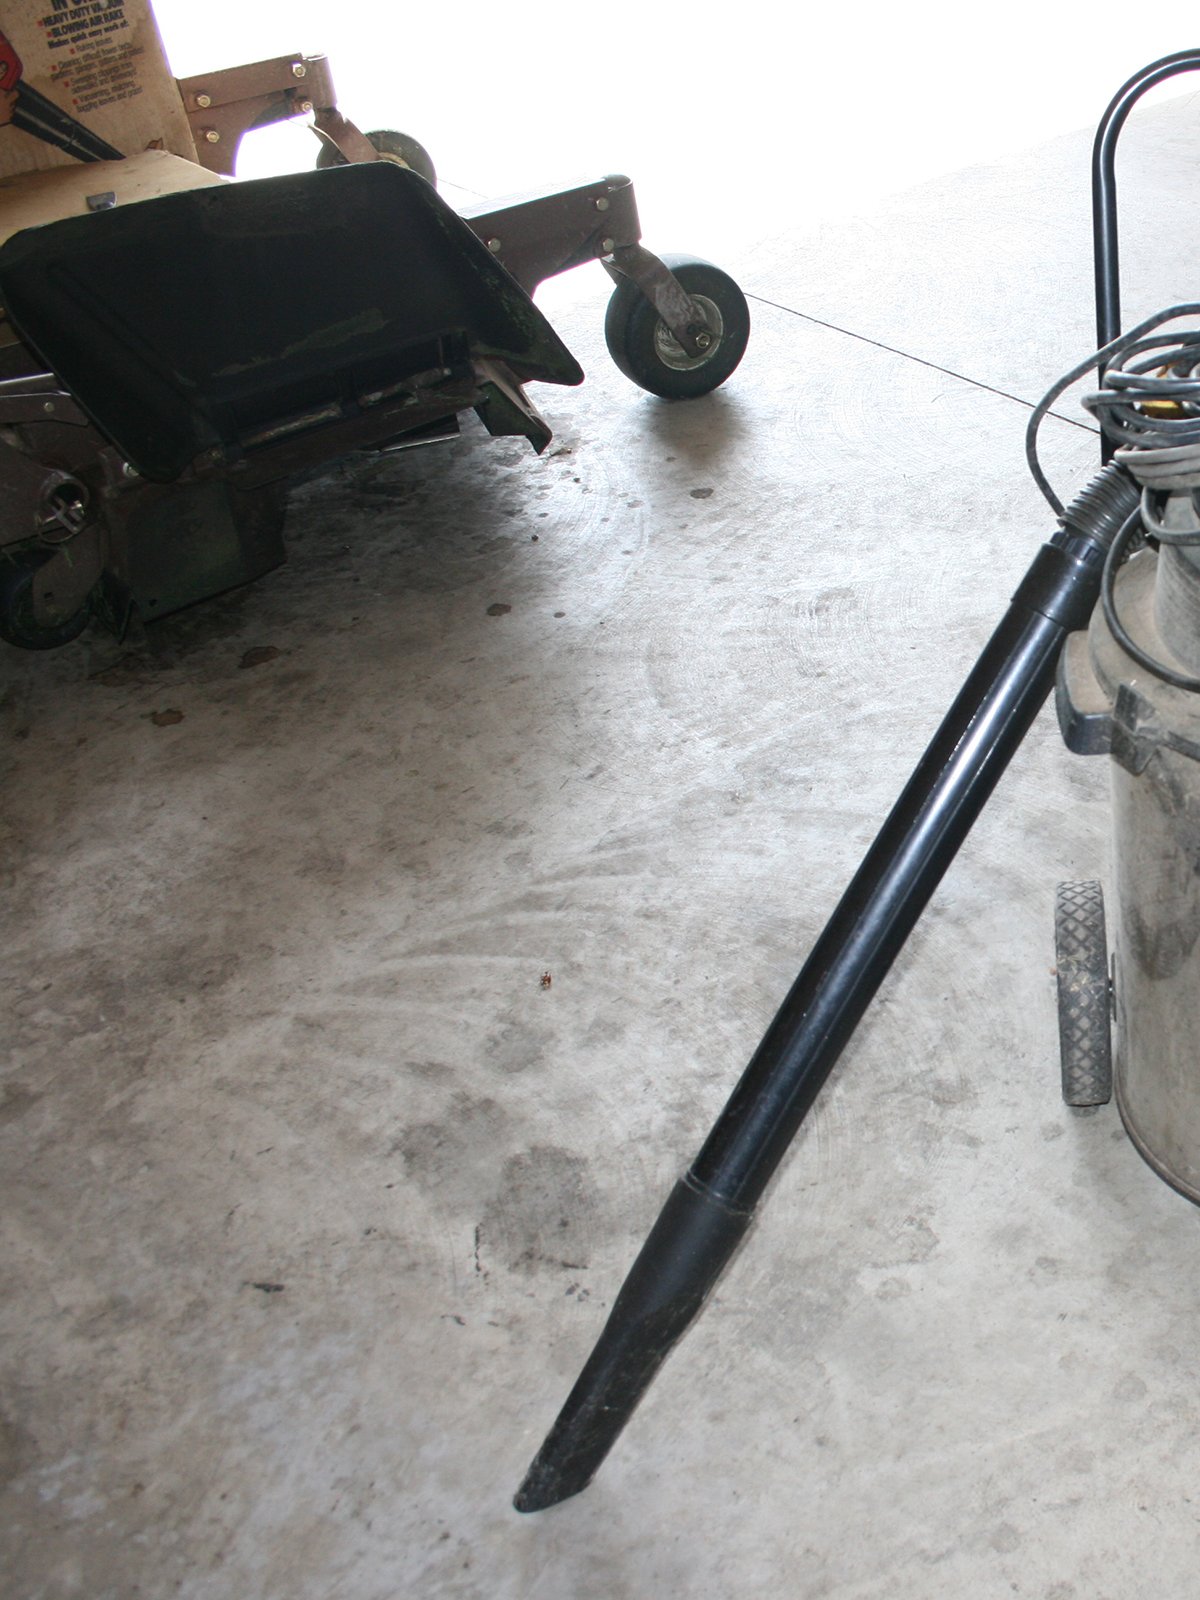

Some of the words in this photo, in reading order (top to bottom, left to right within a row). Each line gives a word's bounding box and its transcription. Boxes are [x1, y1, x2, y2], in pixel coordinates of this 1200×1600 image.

[42, 12, 69, 27] HEAVY
[69, 6, 91, 19] DUTY
[90, 0, 125, 14] VAUUM
[50, 19, 90, 38] BLOWING
[88, 13, 105, 27] AIR
[102, 9, 125, 23] RAKE
[70, 32, 87, 43] quick
[103, 22, 119, 33] work
